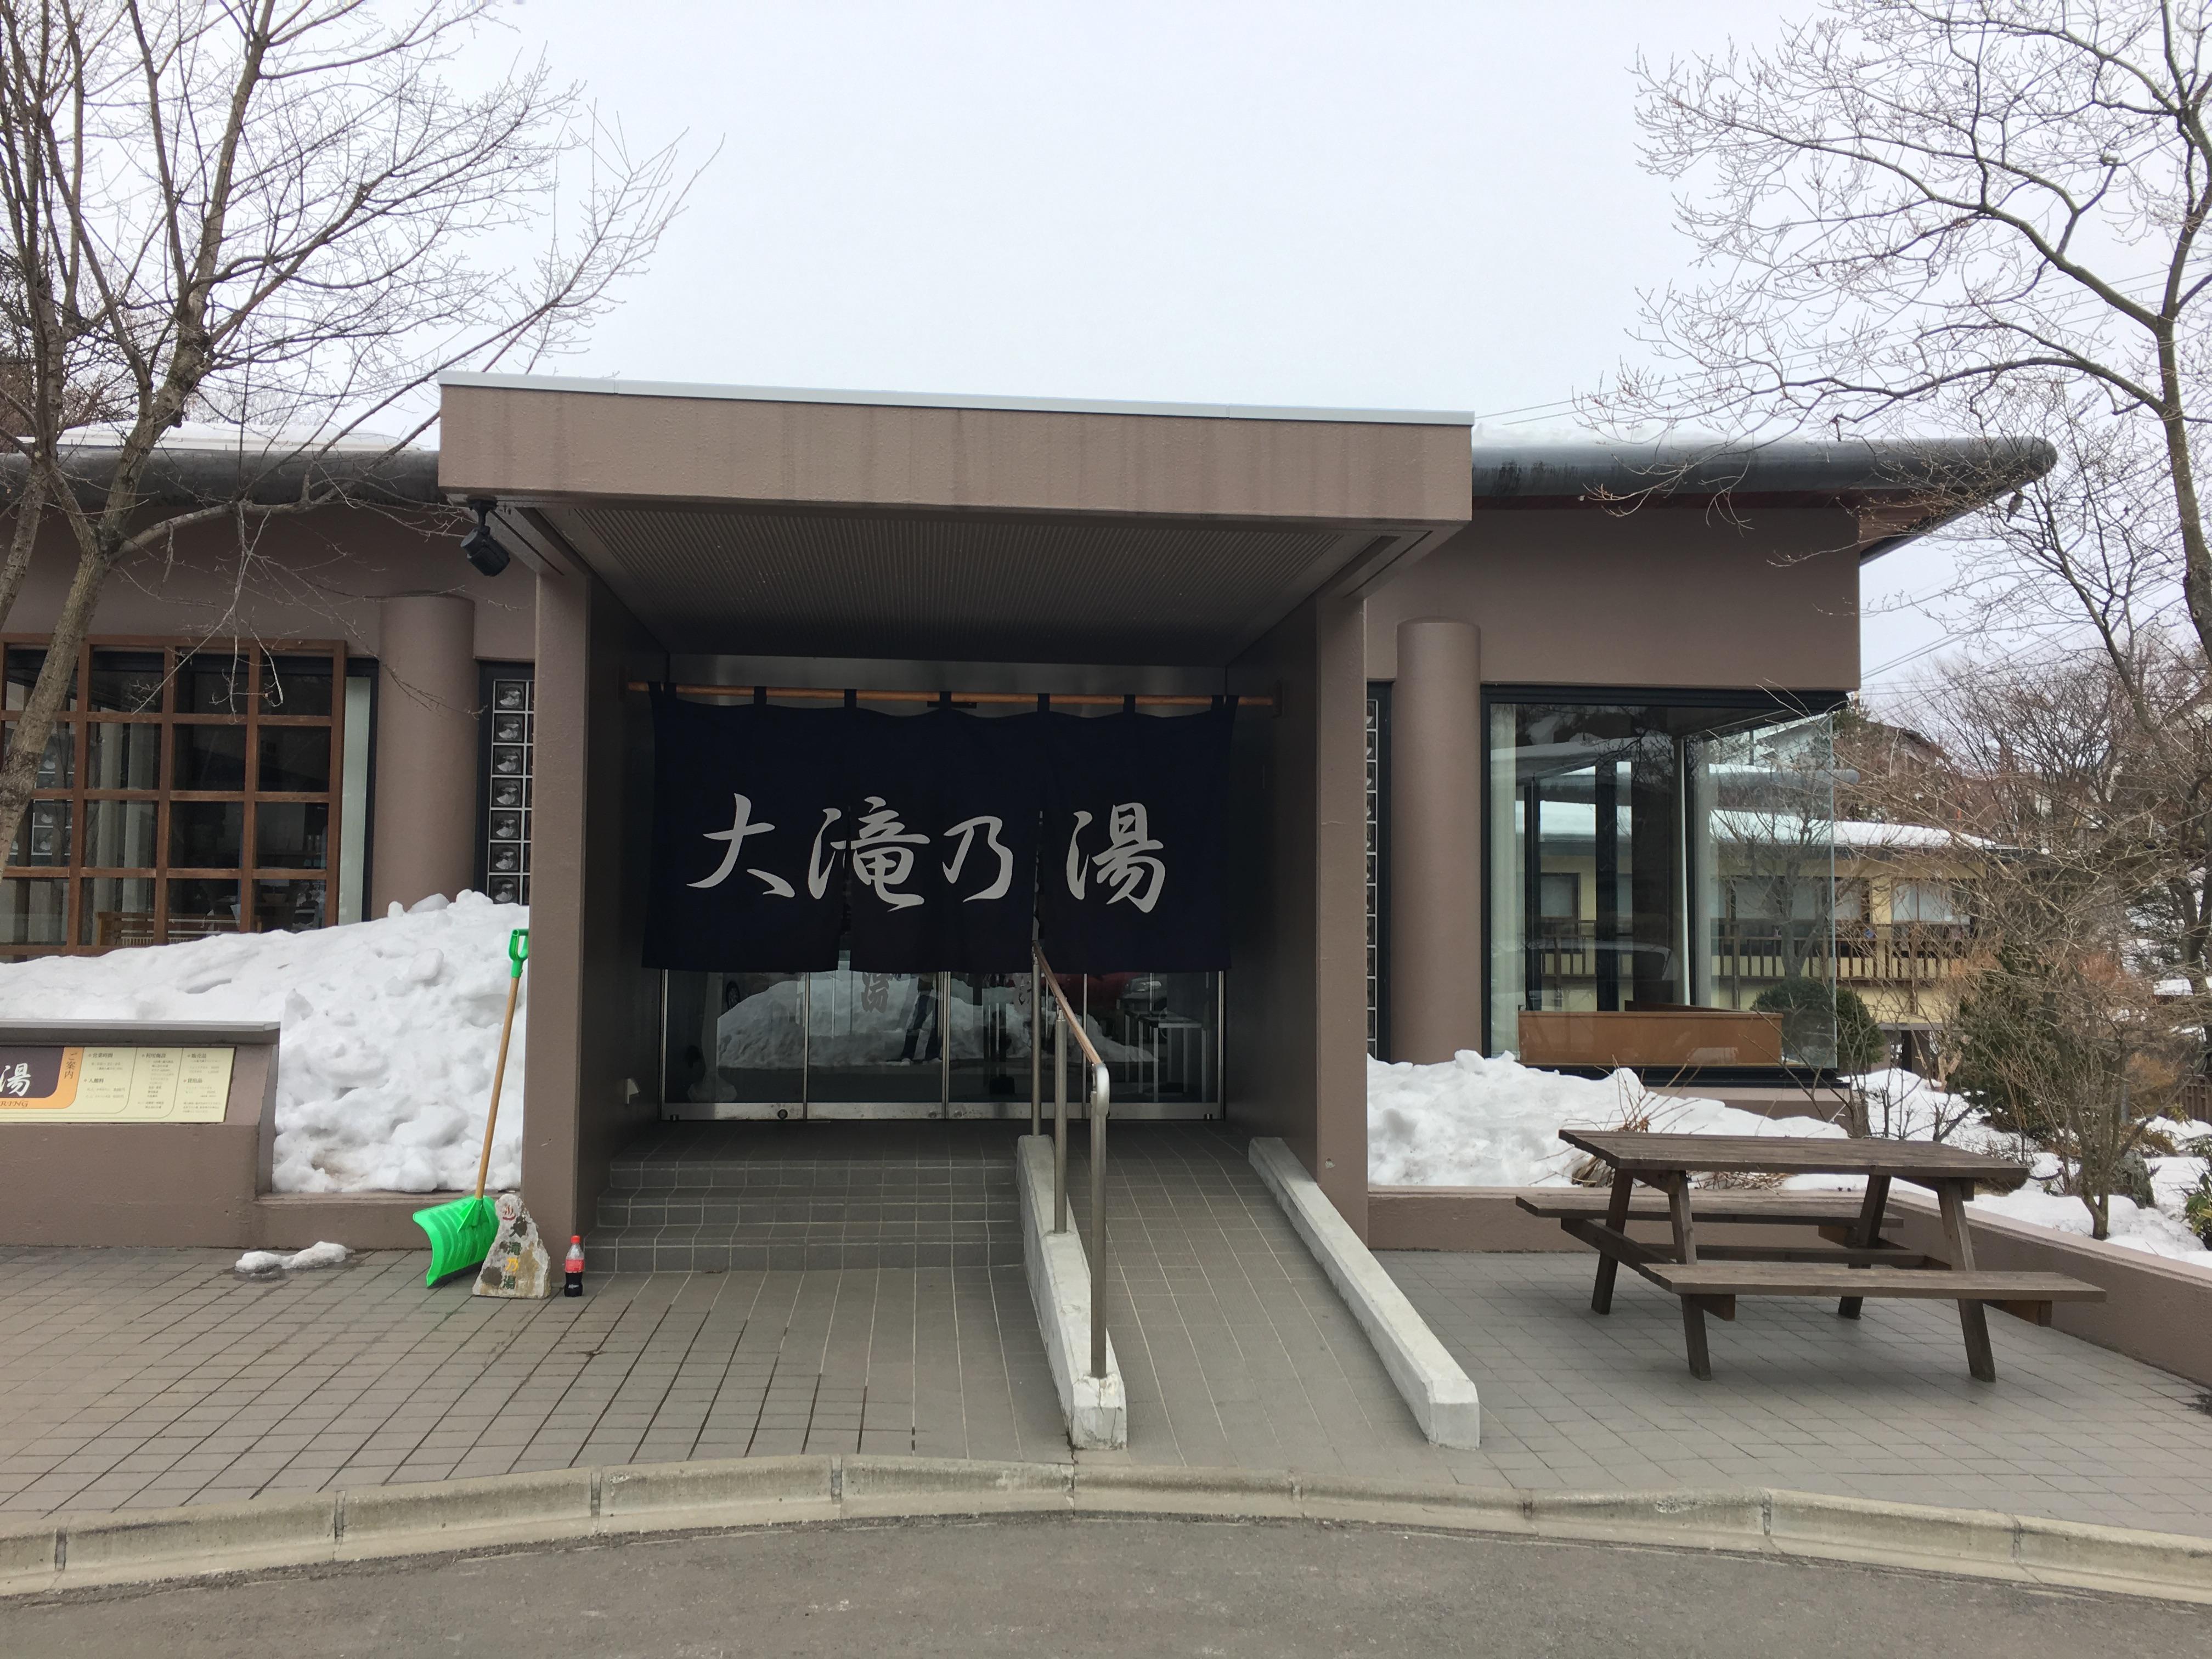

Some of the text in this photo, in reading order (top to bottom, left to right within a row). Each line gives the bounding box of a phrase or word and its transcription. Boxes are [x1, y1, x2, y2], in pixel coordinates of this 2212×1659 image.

[687, 793, 1165, 913] 大滝乃湯
[0, 1063, 31, 1097] 湯
[64, 1052, 77, 1080] ご案内
